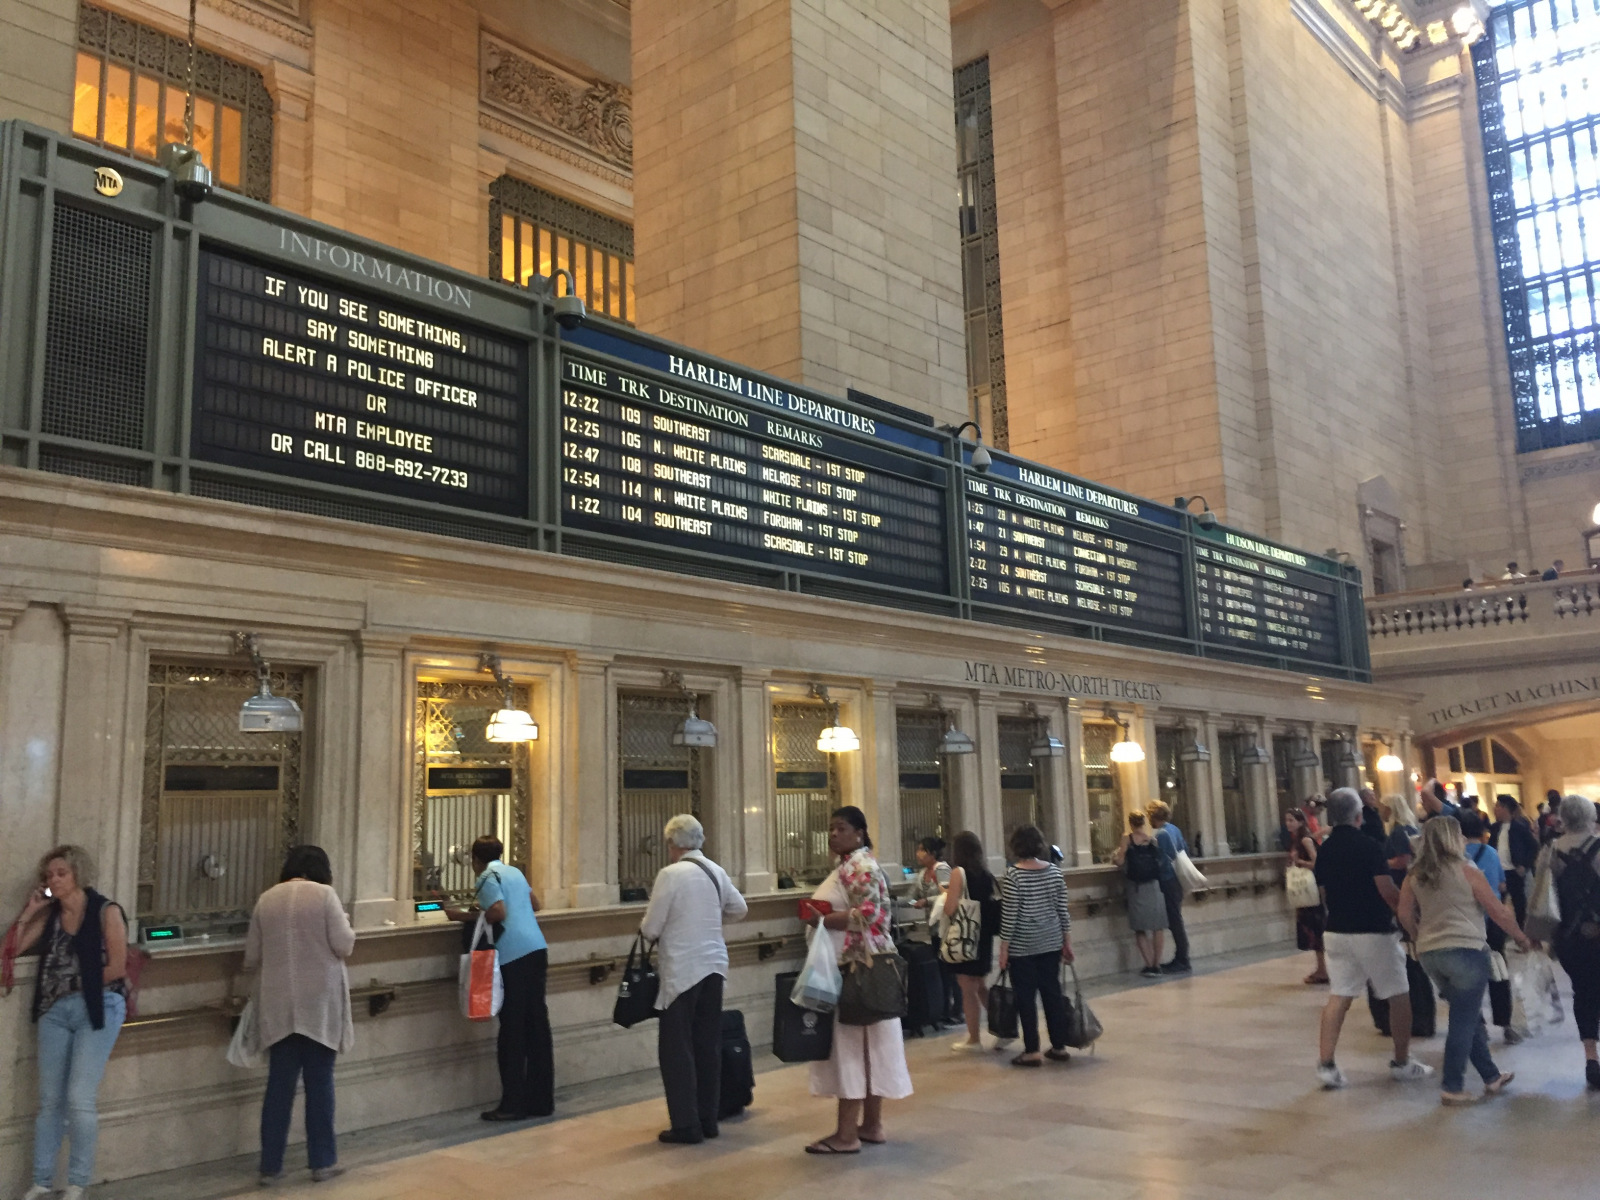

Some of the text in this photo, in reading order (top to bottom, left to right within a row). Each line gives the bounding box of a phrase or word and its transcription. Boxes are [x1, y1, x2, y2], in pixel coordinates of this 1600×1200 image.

[94, 171, 118, 188] MTA
[278, 227, 473, 309] INFORMATION
[264, 276, 466, 353] IF YOU SEE SOMETHING,
[307, 318, 433, 368] SAY SOMETHING
[262, 337, 477, 408] ALERT A POLICE OFFICER
[669, 355, 876, 435] HARLEM LINE DEPARTURES
[366, 393, 386, 414] OR
[568, 361, 822, 448] TIME TRK DESTINATION REMARKS
[315, 411, 432, 453] MTA EMPLOYEE
[564, 390, 599, 413] 12:22
[621, 405, 640, 424] 109
[653, 415, 710, 443] SOUTHEAST
[762, 444, 811, 470] SCARSDALE
[826, 462, 841, 477] 1ST
[844, 467, 865, 483] STOP
[271, 432, 467, 488] OR CALL 888-692-7233
[564, 416, 599, 438] 12:25
[621, 430, 641, 449] 105
[653, 439, 666, 455] N.
[673, 443, 705, 465] WHITE
[710, 453, 746, 475] PLAINS
[762, 466, 801, 488] MELROSE
[816, 480, 831, 496] 1ST
[835, 485, 857, 501] STOP
[564, 441, 599, 462] 12:47
[621, 455, 641, 473] 108
[653, 463, 711, 489] SOUTHEAST
[762, 488, 791, 508] WHITE
[795, 496, 828, 516] PLAINS
[842, 507, 857, 522] 1ST
[860, 512, 881, 527] STOP
[564, 467, 600, 489] 12:54
[622, 479, 641, 497] 114
[654, 487, 666, 503] N.
[673, 490, 706, 511] WHITE
[711, 499, 747, 520] PLAINS
[763, 510, 803, 532] FORDHAM
[818, 523, 833, 538] 1ST
[837, 527, 858, 543] STOP
[967, 479, 1109, 529] TIME TRK DESTINATION REMARKS
[1019, 468, 1138, 516] HARLEM LINE DEPARTURES
[570, 494, 600, 514] 1:22
[622, 504, 641, 522] 104
[654, 511, 712, 536] SOUTHEAST
[763, 533, 814, 556] SCARSDALE
[828, 546, 844, 561] 1ST
[847, 550, 868, 565] STOP
[967, 500, 983, 515] 1:25
[1022, 516, 1041, 530] WHITE
[968, 519, 984, 532] 1:47
[1012, 530, 1045, 548] SOUTHEAST
[969, 538, 985, 551] 1:54
[1024, 551, 1043, 565] WHITE
[969, 556, 986, 570] 2:22
[1014, 566, 1047, 583] SOUTHEAST
[1226, 533, 1254, 552] HUDSON
[1256, 542, 1270, 556] LINE
[965, 661, 1162, 701] MTA METRO-NORTH TICKETS
[1427, 694, 1499, 724] TICKET
